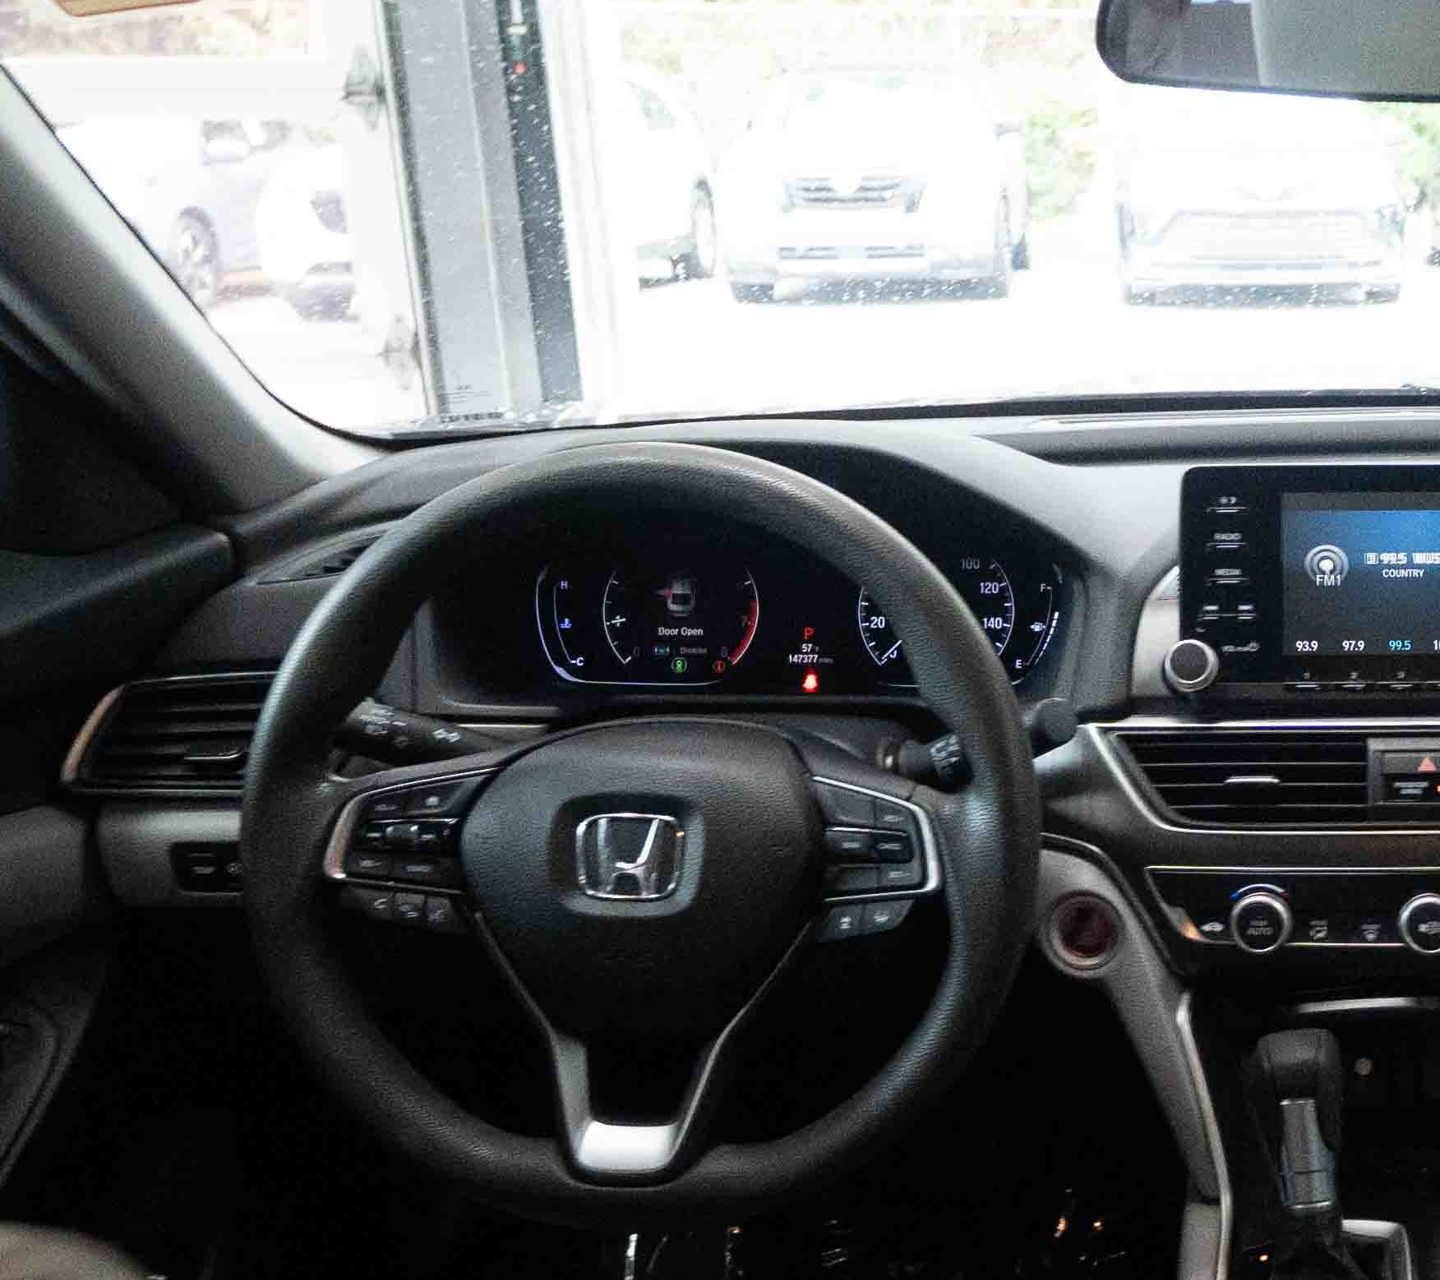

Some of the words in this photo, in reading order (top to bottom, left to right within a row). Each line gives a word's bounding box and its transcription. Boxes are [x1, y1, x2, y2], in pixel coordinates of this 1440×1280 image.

[1382, 568, 1425, 579] COUNTRY
[560, 581, 568, 590] H
[1316, 574, 1341, 587] FM1
[980, 582, 999, 594] 120
[1040, 584, 1047, 593] F
[870, 616, 885, 629] 20
[983, 616, 1003, 628] 140
[658, 626, 679, 636] Door
[680, 626, 704, 638] Open
[804, 627, 815, 640] P
[1296, 640, 1318, 651] 93.9
[1342, 640, 1365, 651] 97.9
[1388, 640, 1411, 651] 99.5
[577, 657, 585, 666] C
[789, 653, 817, 664] 147377
[1016, 659, 1023, 669] E
